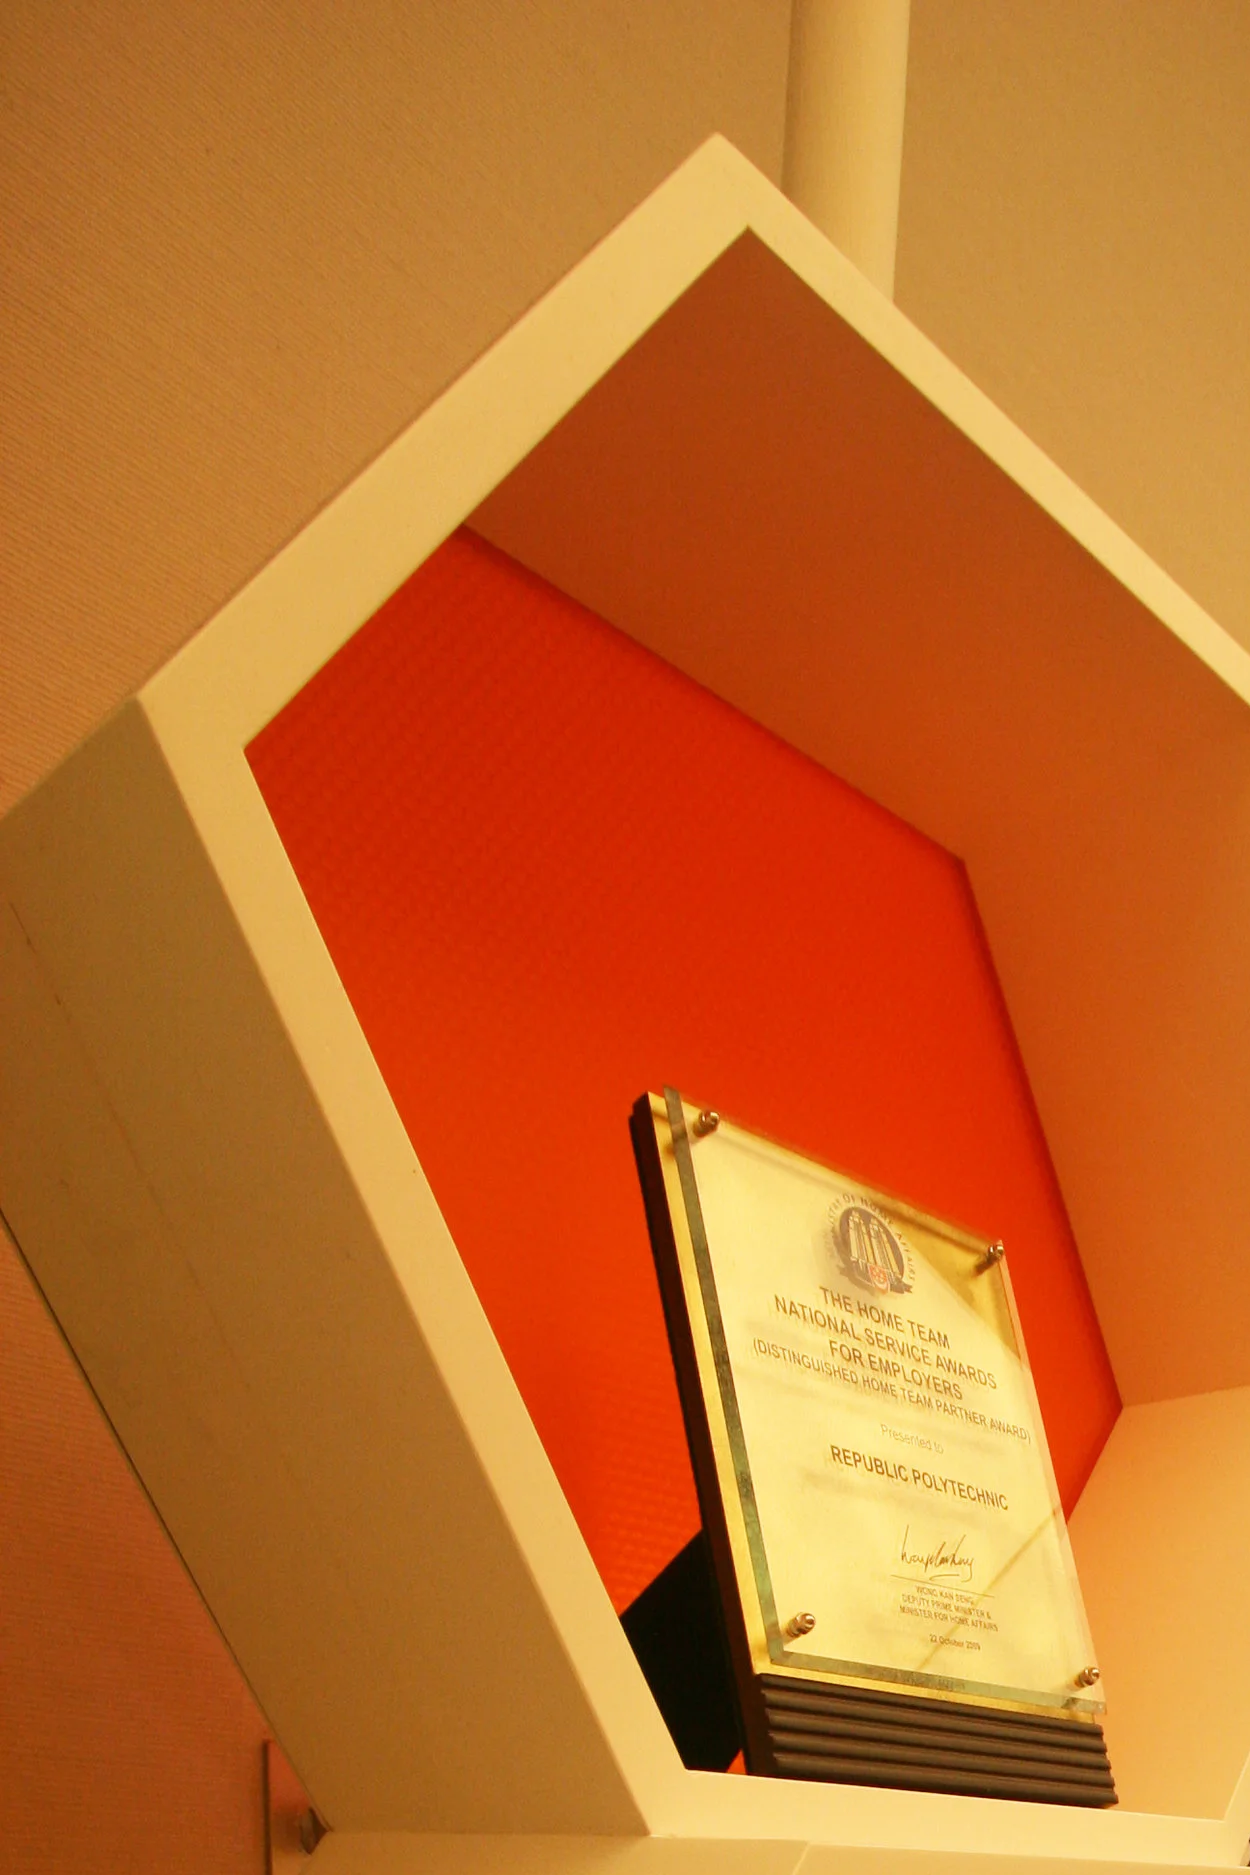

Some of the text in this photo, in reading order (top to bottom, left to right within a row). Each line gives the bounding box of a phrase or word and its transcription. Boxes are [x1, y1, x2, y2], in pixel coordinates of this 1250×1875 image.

[775, 1294, 997, 1390] NATIONAL SERVICE AWARDS
[819, 1286, 950, 1350] THE HOME TEAM
[753, 1338, 1031, 1444] (DISTINGUISHED HOME TEAM PARTNER AWARD)
[829, 1340, 963, 1400] FOR EMPLOYERS
[880, 1423, 944, 1455] Presented to
[830, 1444, 1008, 1511] REPUBLIC POLYTECHNIC
